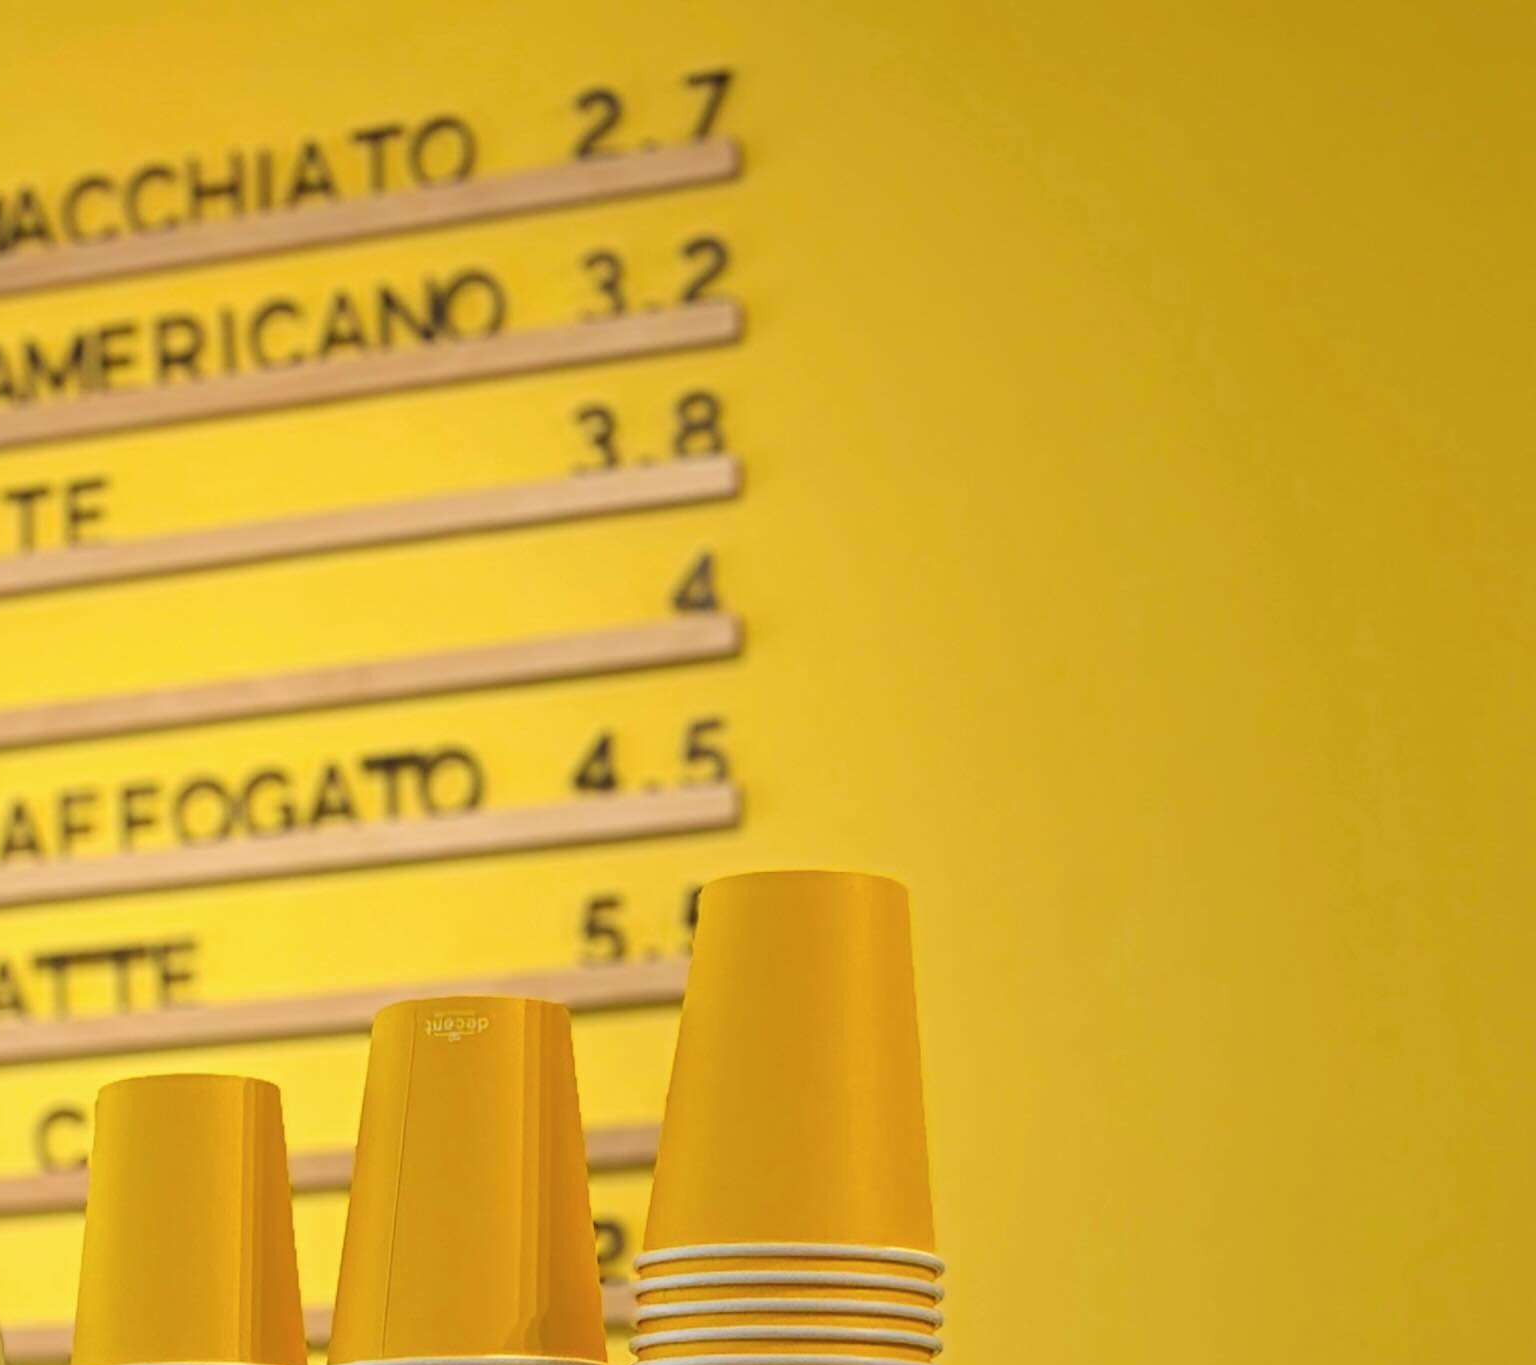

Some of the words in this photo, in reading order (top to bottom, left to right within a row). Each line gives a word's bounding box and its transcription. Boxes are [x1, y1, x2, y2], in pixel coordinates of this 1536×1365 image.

[574, 69, 733, 159] 2.7
[581, 237, 730, 323] 3.2
[574, 390, 724, 470] 3.8
[672, 552, 717, 613] 4
[573, 717, 729, 796] 4.5
